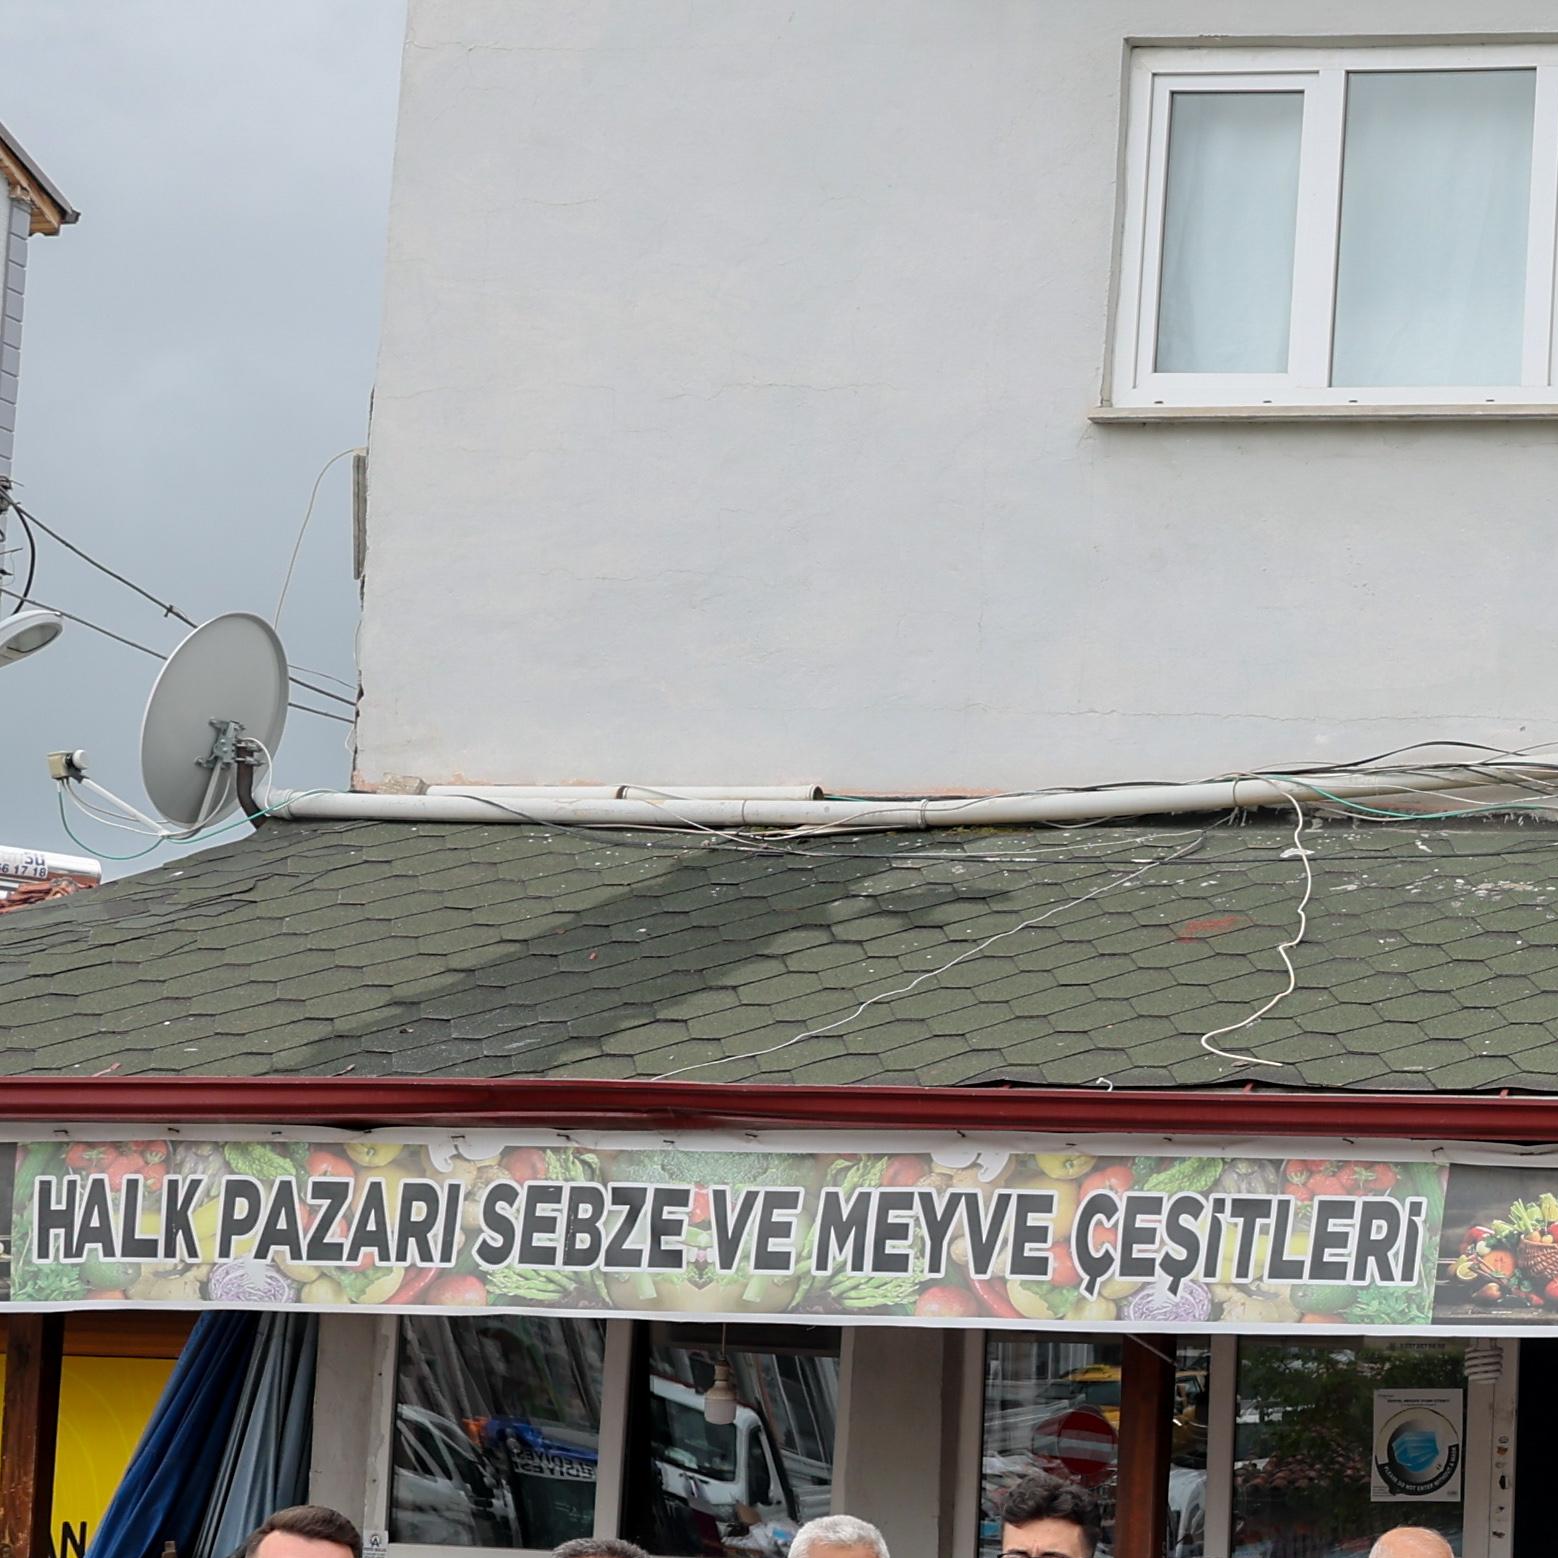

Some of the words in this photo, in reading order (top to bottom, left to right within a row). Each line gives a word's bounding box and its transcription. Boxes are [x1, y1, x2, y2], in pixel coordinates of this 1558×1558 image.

[34, 1175, 204, 1263] HALK
[219, 1177, 463, 1266] PAZARI
[476, 1181, 692, 1270] SEBZE
[713, 1186, 803, 1275] VE
[814, 1189, 1058, 1281] MEYVE
[1074, 1192, 1424, 1299] ÇEŞİTLERİ
